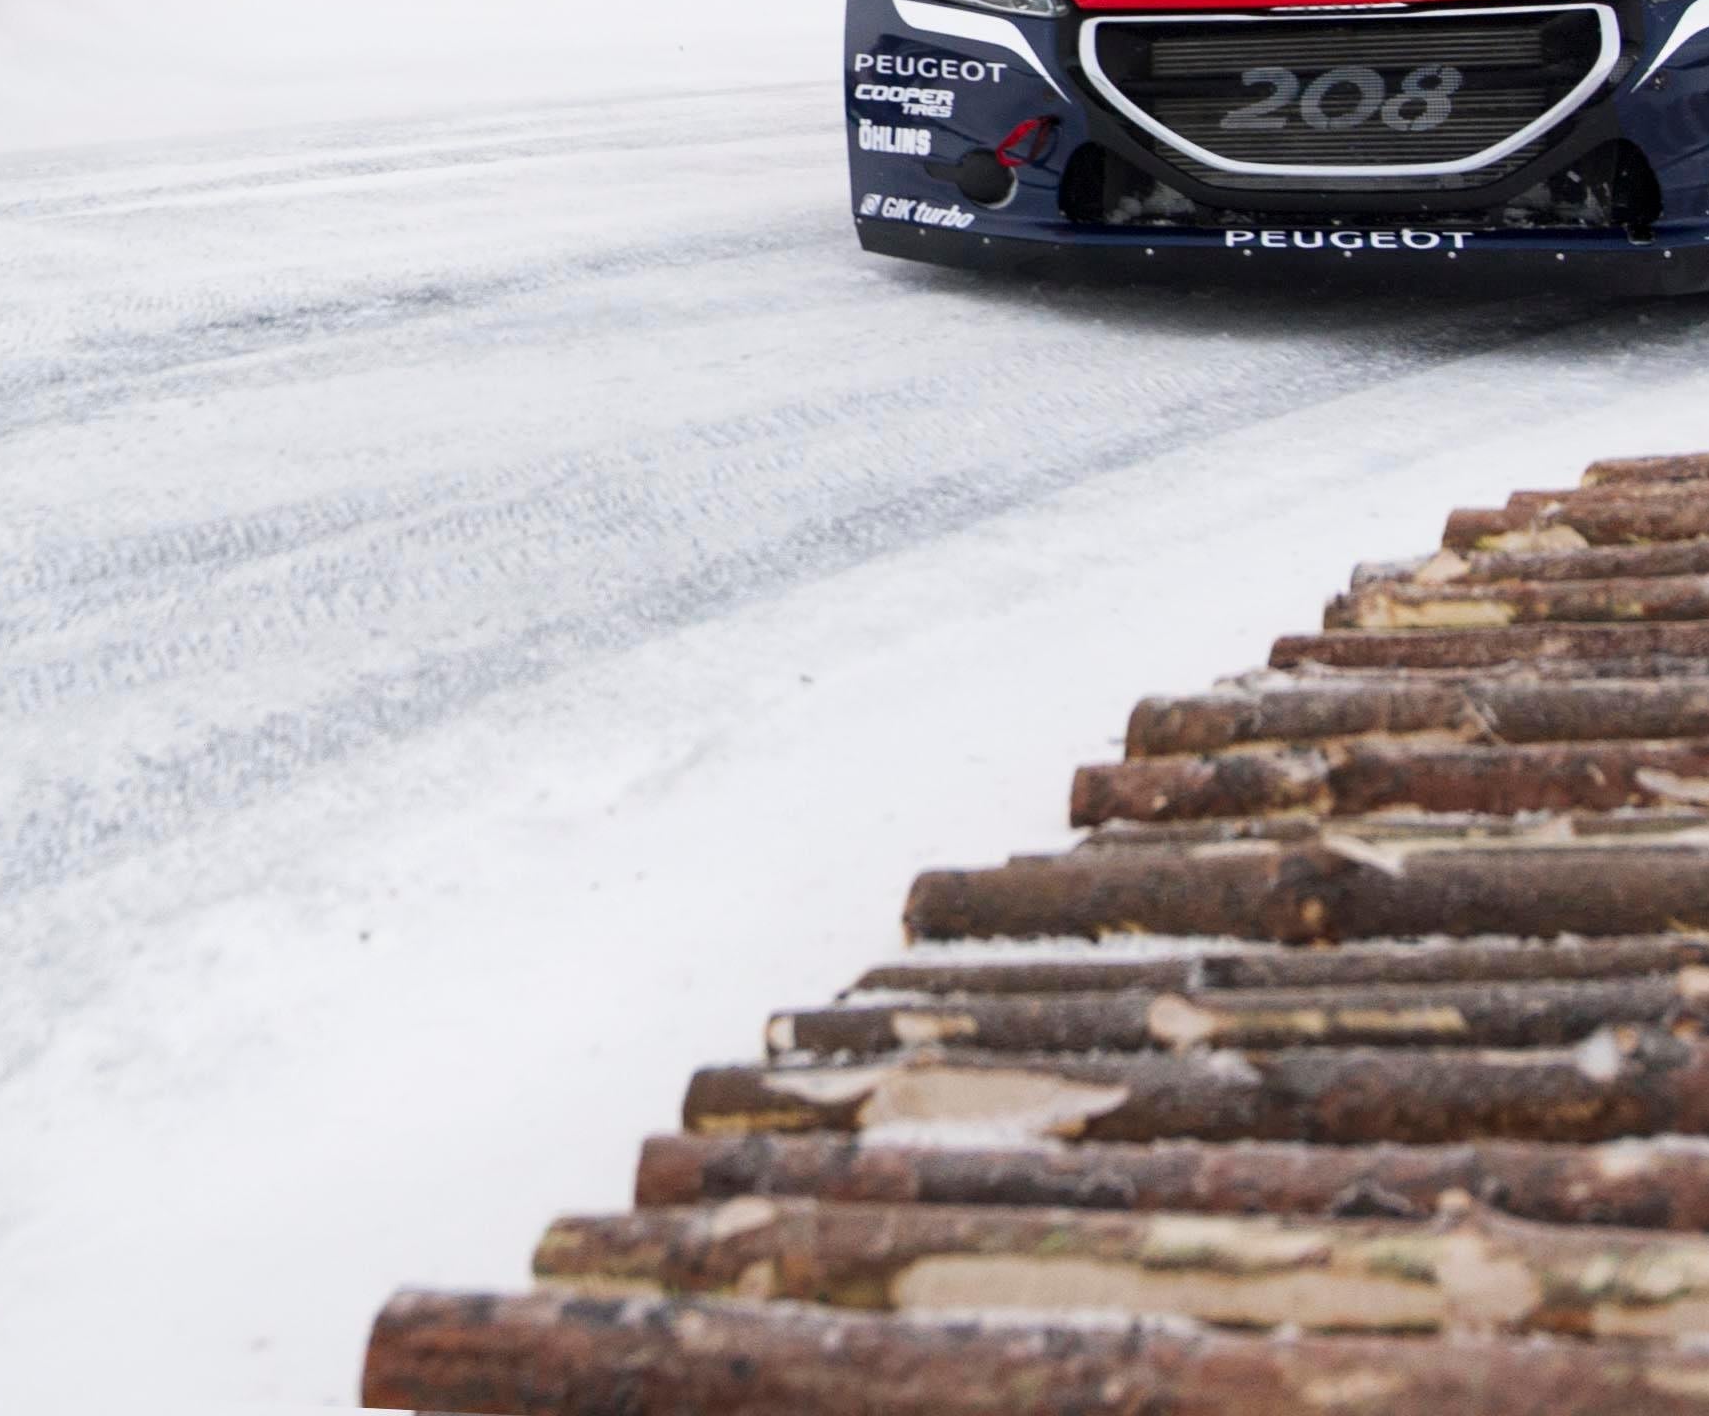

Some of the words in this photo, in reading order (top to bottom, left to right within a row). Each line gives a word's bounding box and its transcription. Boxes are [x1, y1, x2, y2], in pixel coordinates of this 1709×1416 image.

[854, 53, 1007, 83] PEUGEOT
[854, 84, 955, 106] COOPER
[902, 102, 953, 118] TIRES
[1219, 64, 1463, 132] 208
[858, 119, 932, 156] ÖHLINS
[881, 197, 917, 222] GIK
[913, 202, 975, 229] turbo
[1225, 230, 1474, 249] PEUGEOT
